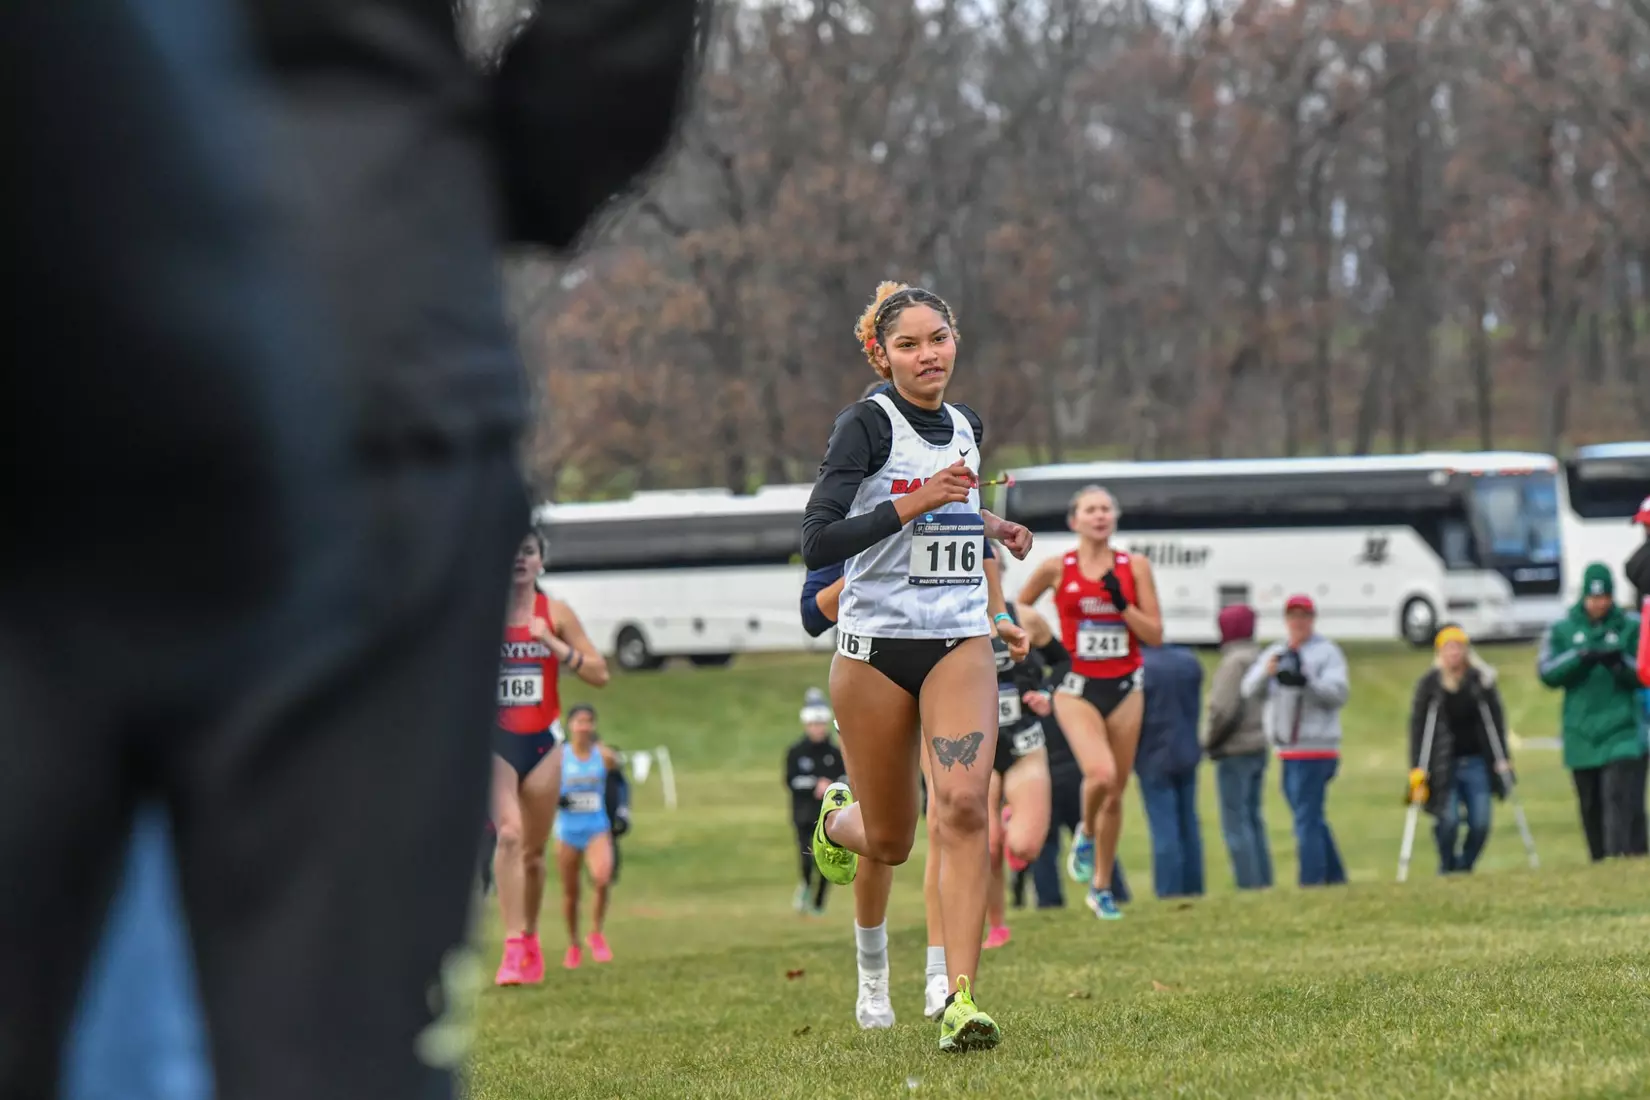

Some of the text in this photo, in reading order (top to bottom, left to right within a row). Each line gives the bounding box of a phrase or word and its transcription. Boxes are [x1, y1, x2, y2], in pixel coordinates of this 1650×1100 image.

[926, 541, 976, 572] 116
[1087, 637, 1120, 652] 241
[500, 679, 535, 697] 168
